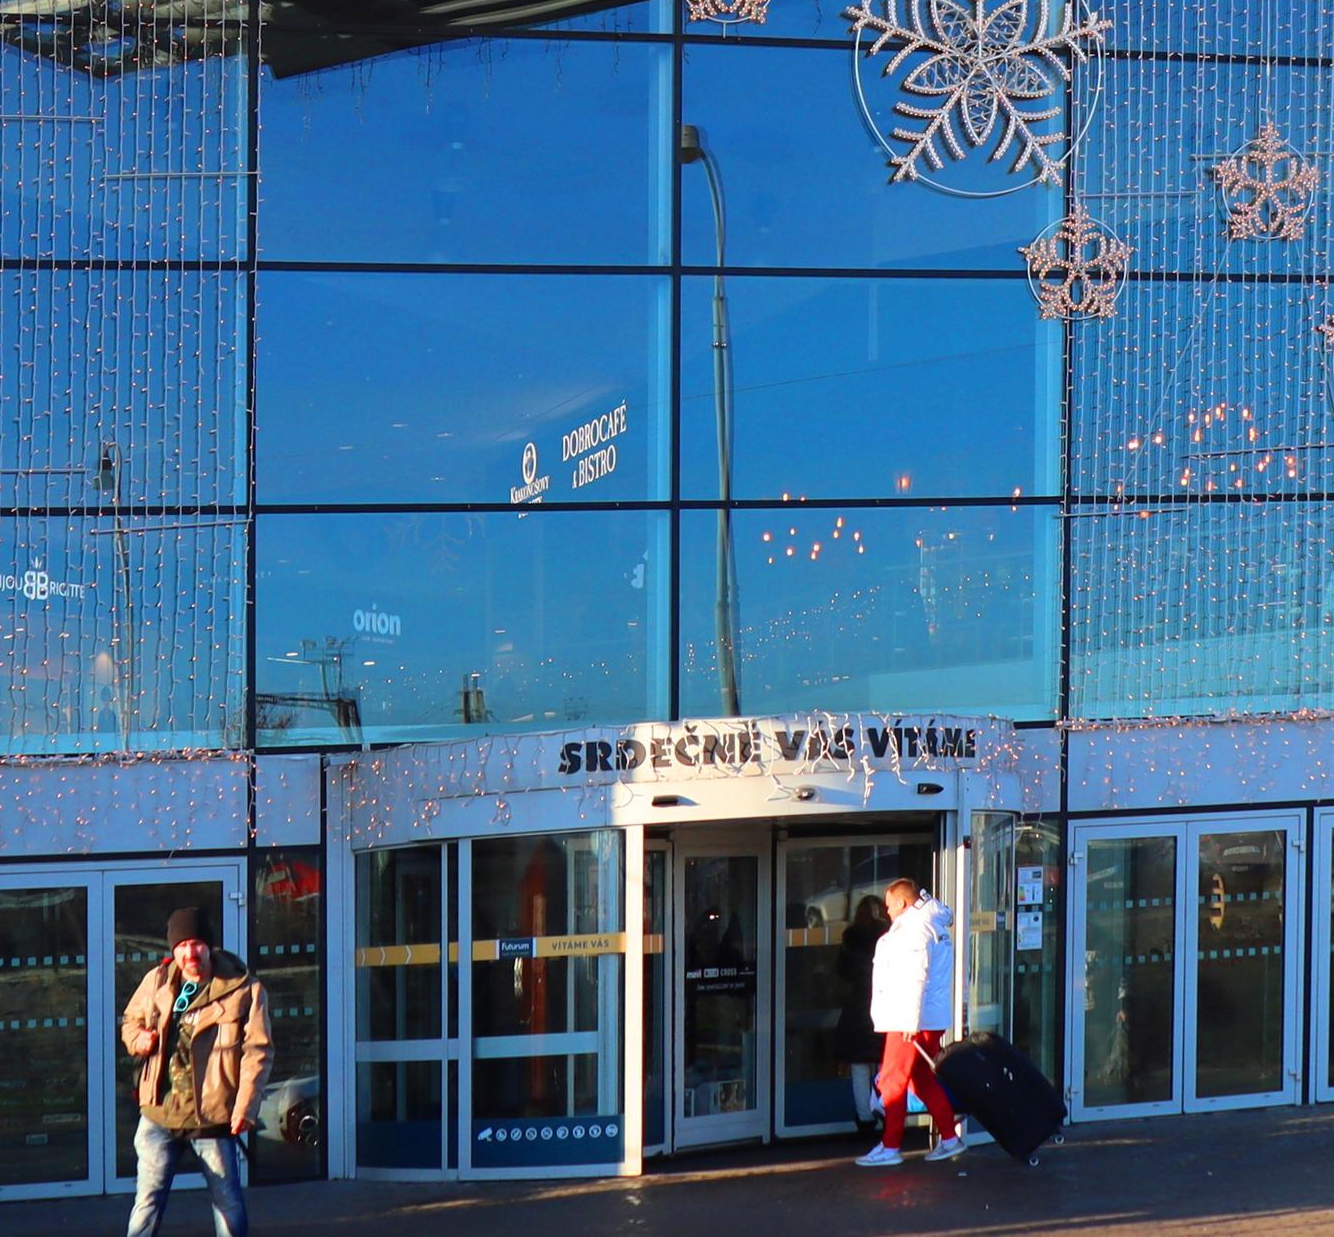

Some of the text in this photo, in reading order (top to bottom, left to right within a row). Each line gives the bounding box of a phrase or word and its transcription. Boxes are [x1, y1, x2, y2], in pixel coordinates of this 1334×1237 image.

[562, 398, 627, 462] DOBROCAFÉ
[578, 444, 617, 488] BISTRO
[352, 603, 402, 636] orion
[774, 719, 855, 761] VÁS
[867, 717, 977, 759] VÍTÁME
[551, 941, 588, 951] VÍTÁME
[590, 939, 610, 949] VÁS
